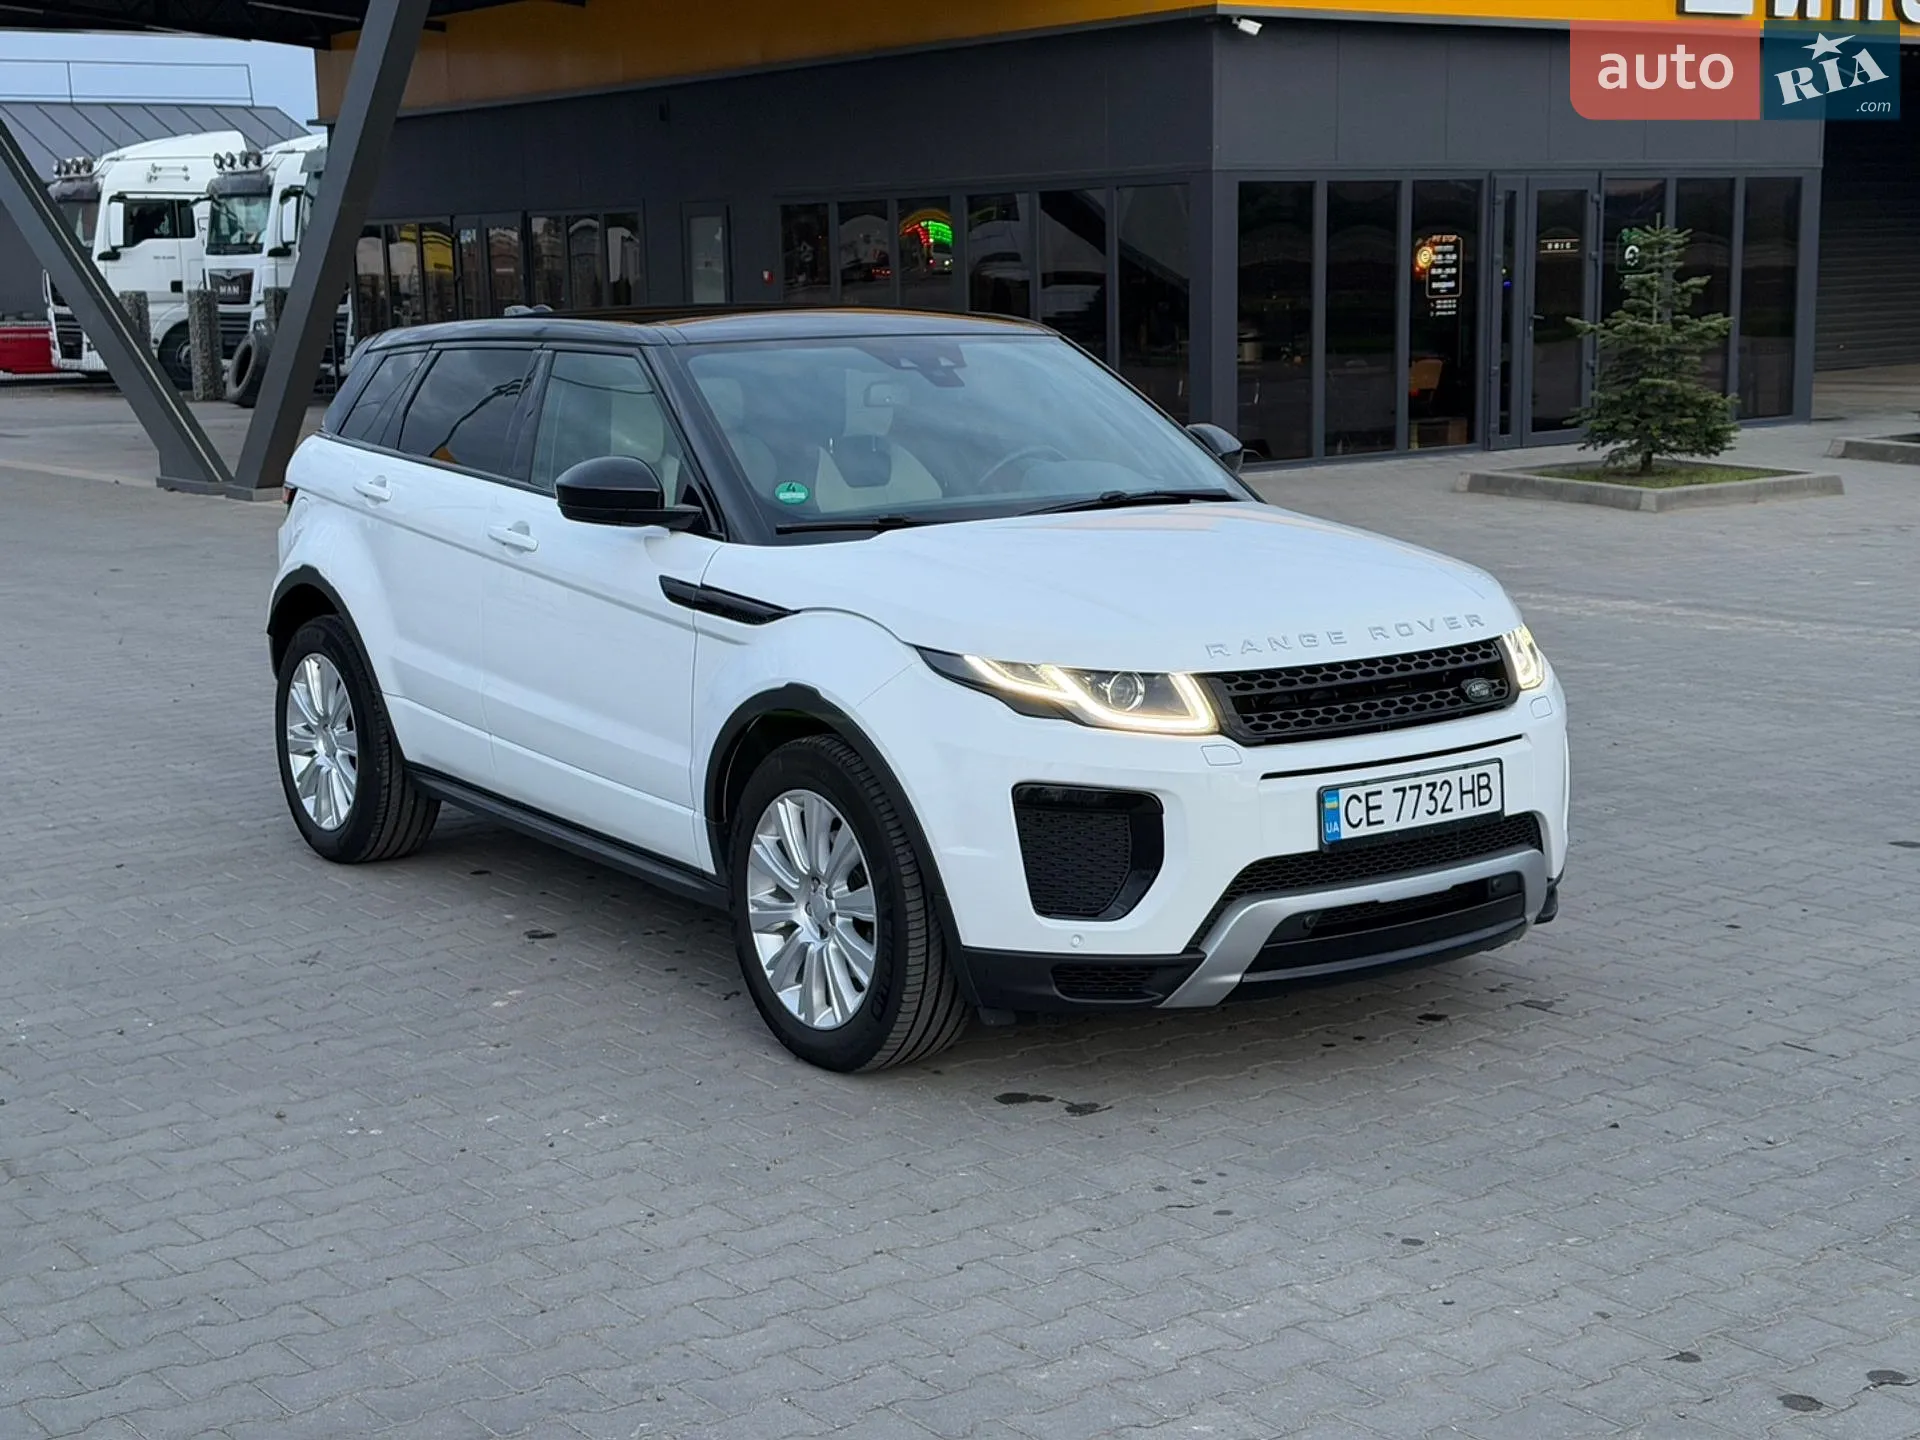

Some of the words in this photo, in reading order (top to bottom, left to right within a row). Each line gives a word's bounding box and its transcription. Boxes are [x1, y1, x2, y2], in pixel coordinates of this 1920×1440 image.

[1204, 631, 1348, 659] RANGE
[1368, 614, 1486, 641] ROVER
[1344, 790, 1385, 829] CE
[1392, 779, 1453, 822] 7732
[1459, 772, 1493, 810] HB
[1325, 822, 1340, 833] UA
